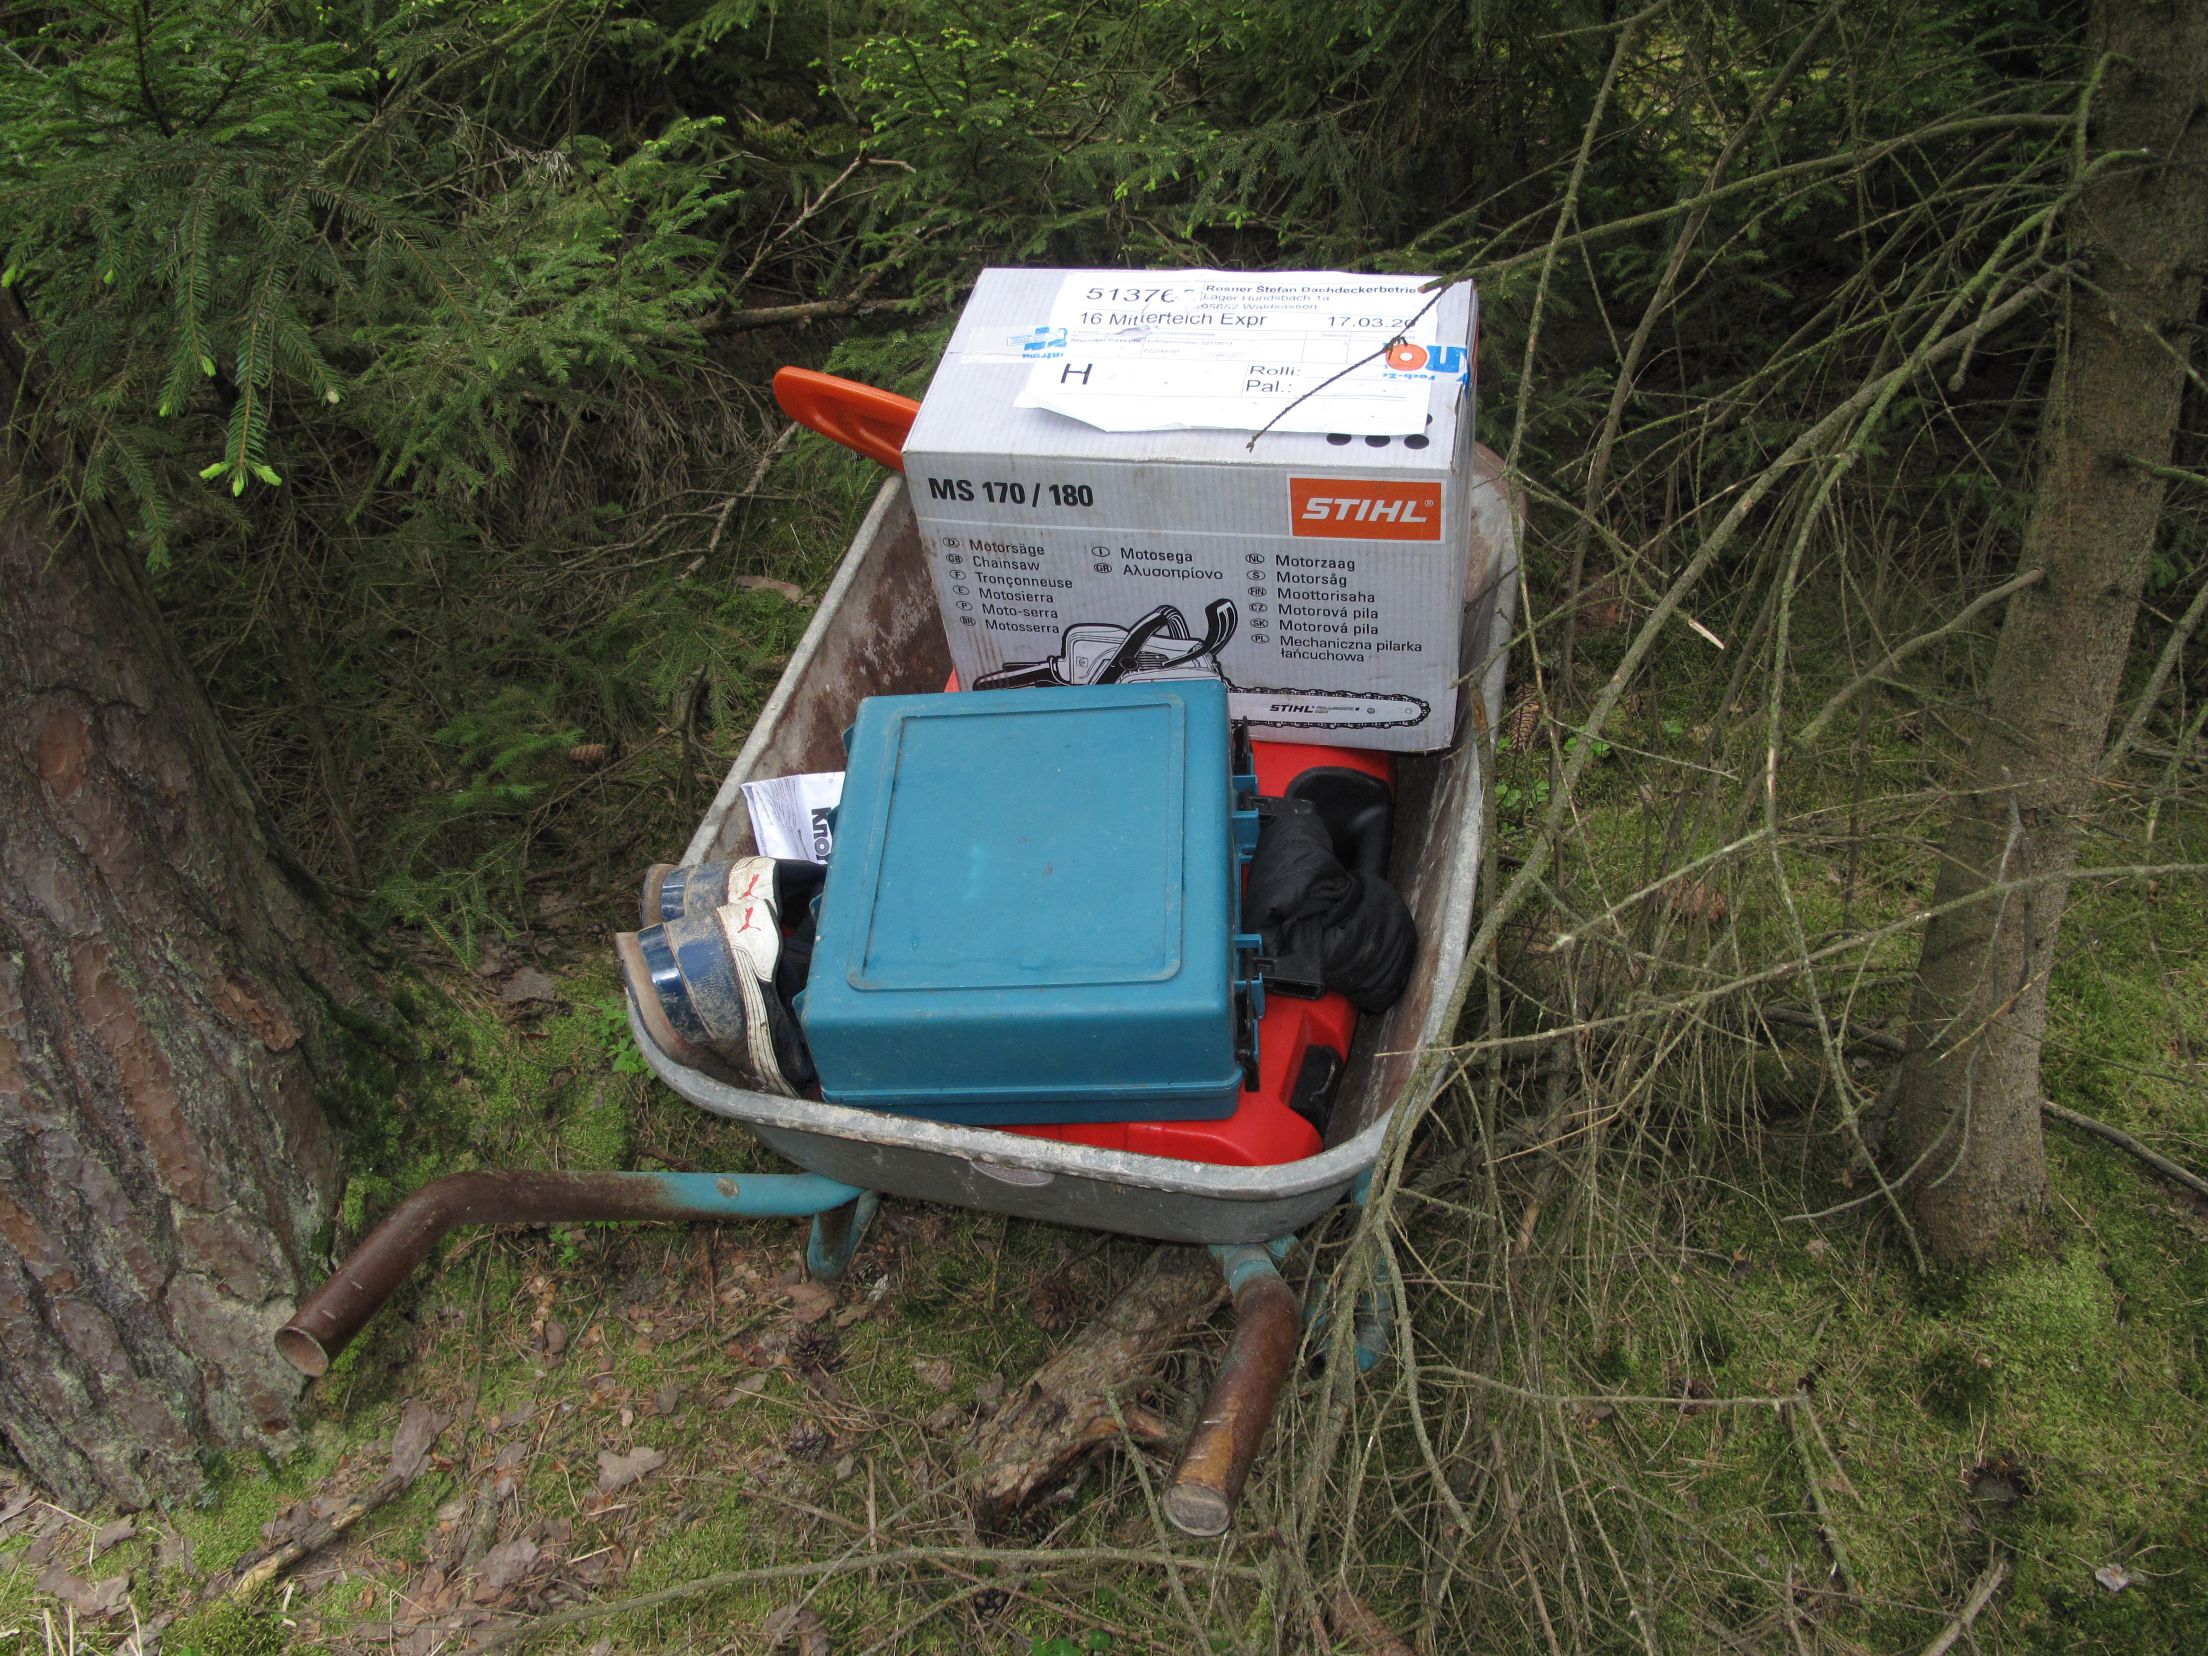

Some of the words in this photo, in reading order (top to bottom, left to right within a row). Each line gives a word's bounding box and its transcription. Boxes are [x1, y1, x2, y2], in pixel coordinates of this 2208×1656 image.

[1203, 293, 1238, 302] Lager
[1205, 285, 1252, 293] Rosner
[1256, 285, 1297, 293] Stefan
[1301, 286, 1418, 294] Dachdeckerbetrie
[1080, 312, 1103, 325] 16
[1220, 312, 1268, 328] Expr
[1060, 363, 1093, 385] H
[1249, 365, 1301, 376] Rolli:
[928, 477, 975, 502] MS
[982, 481, 1026, 504] 170
[1049, 484, 1094, 507] 180
[1301, 497, 1428, 523] STIHL
[969, 539, 1045, 557] Motorsäge
[1120, 547, 1193, 564] Motosega
[972, 555, 1040, 571] Chainsaw
[1275, 554, 1356, 572] Motorzaag
[974, 571, 1073, 589] Tronçonneuse
[1122, 564, 1223, 581] Αλυσοπρίονο
[1276, 571, 1347, 588] Motorsåg
[978, 587, 1054, 604] Motosierra
[1277, 587, 1376, 603] Moottorisaha
[982, 603, 1059, 619] Moto-serra
[1278, 603, 1348, 618] Motorová
[1353, 607, 1379, 621] pila
[985, 619, 1060, 634] Motosserra
[1279, 619, 1348, 634] Motorová
[1353, 623, 1379, 637] pila
[1280, 635, 1372, 650] Mechaniczna
[1376, 640, 1423, 653] pilarka
[1281, 648, 1365, 662] łańcuchowa
[1269, 704, 1314, 713] STIHL
